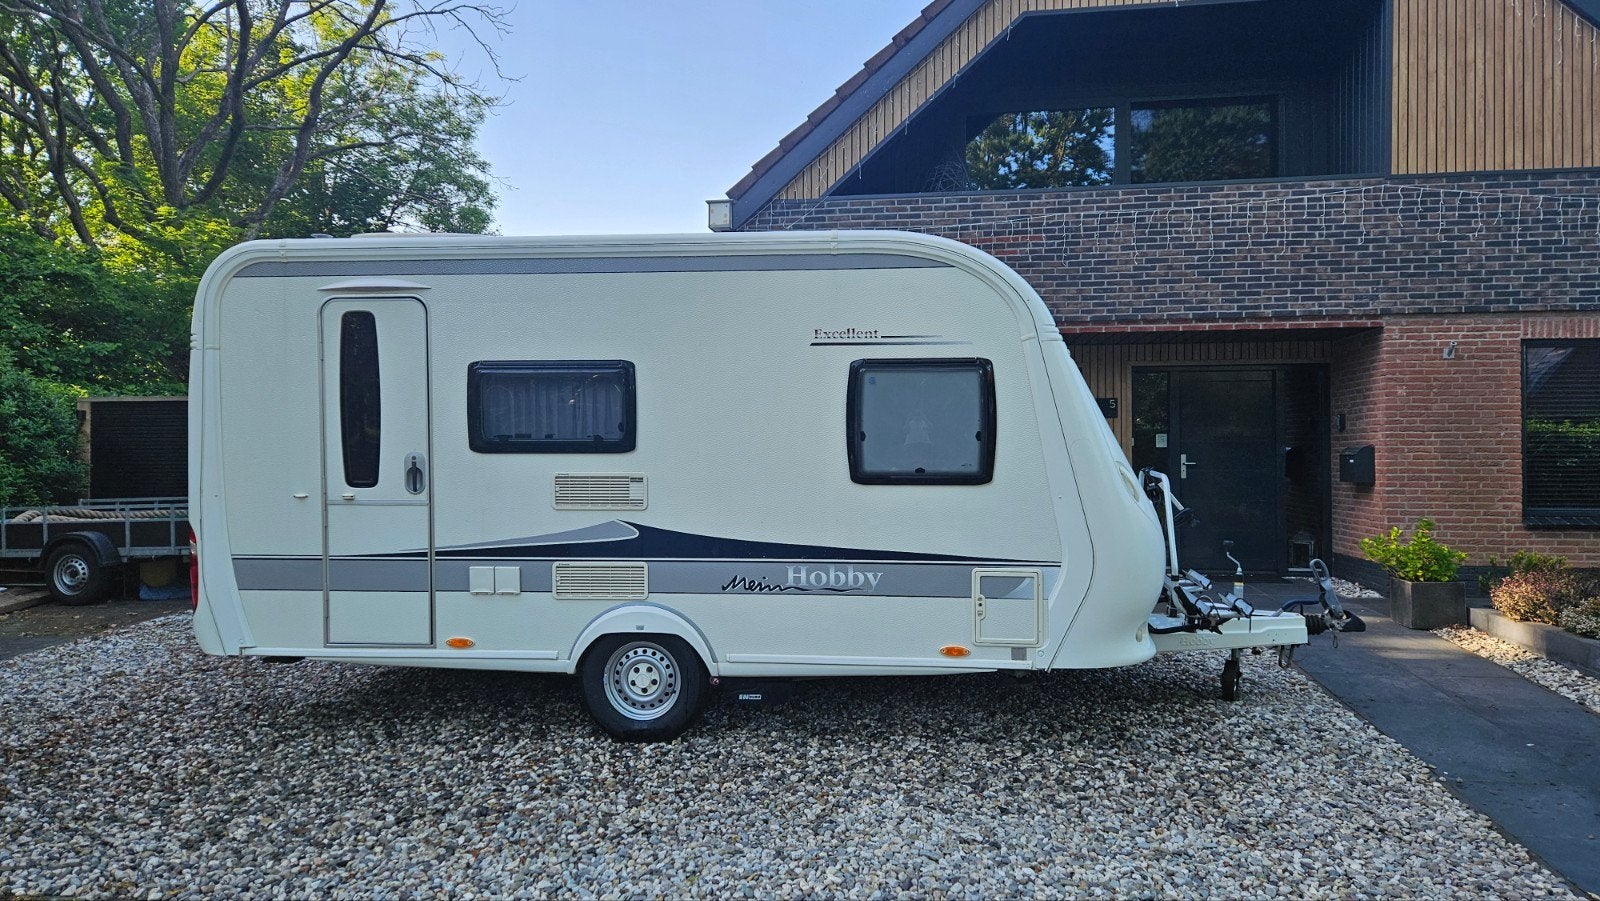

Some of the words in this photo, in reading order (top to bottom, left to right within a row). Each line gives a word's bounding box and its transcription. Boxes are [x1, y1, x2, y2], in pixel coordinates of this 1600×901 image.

[814, 328, 879, 339] Excellent
[1109, 399, 1116, 409] 5
[721, 575, 786, 592] Mein
[785, 565, 884, 593] Hobby
